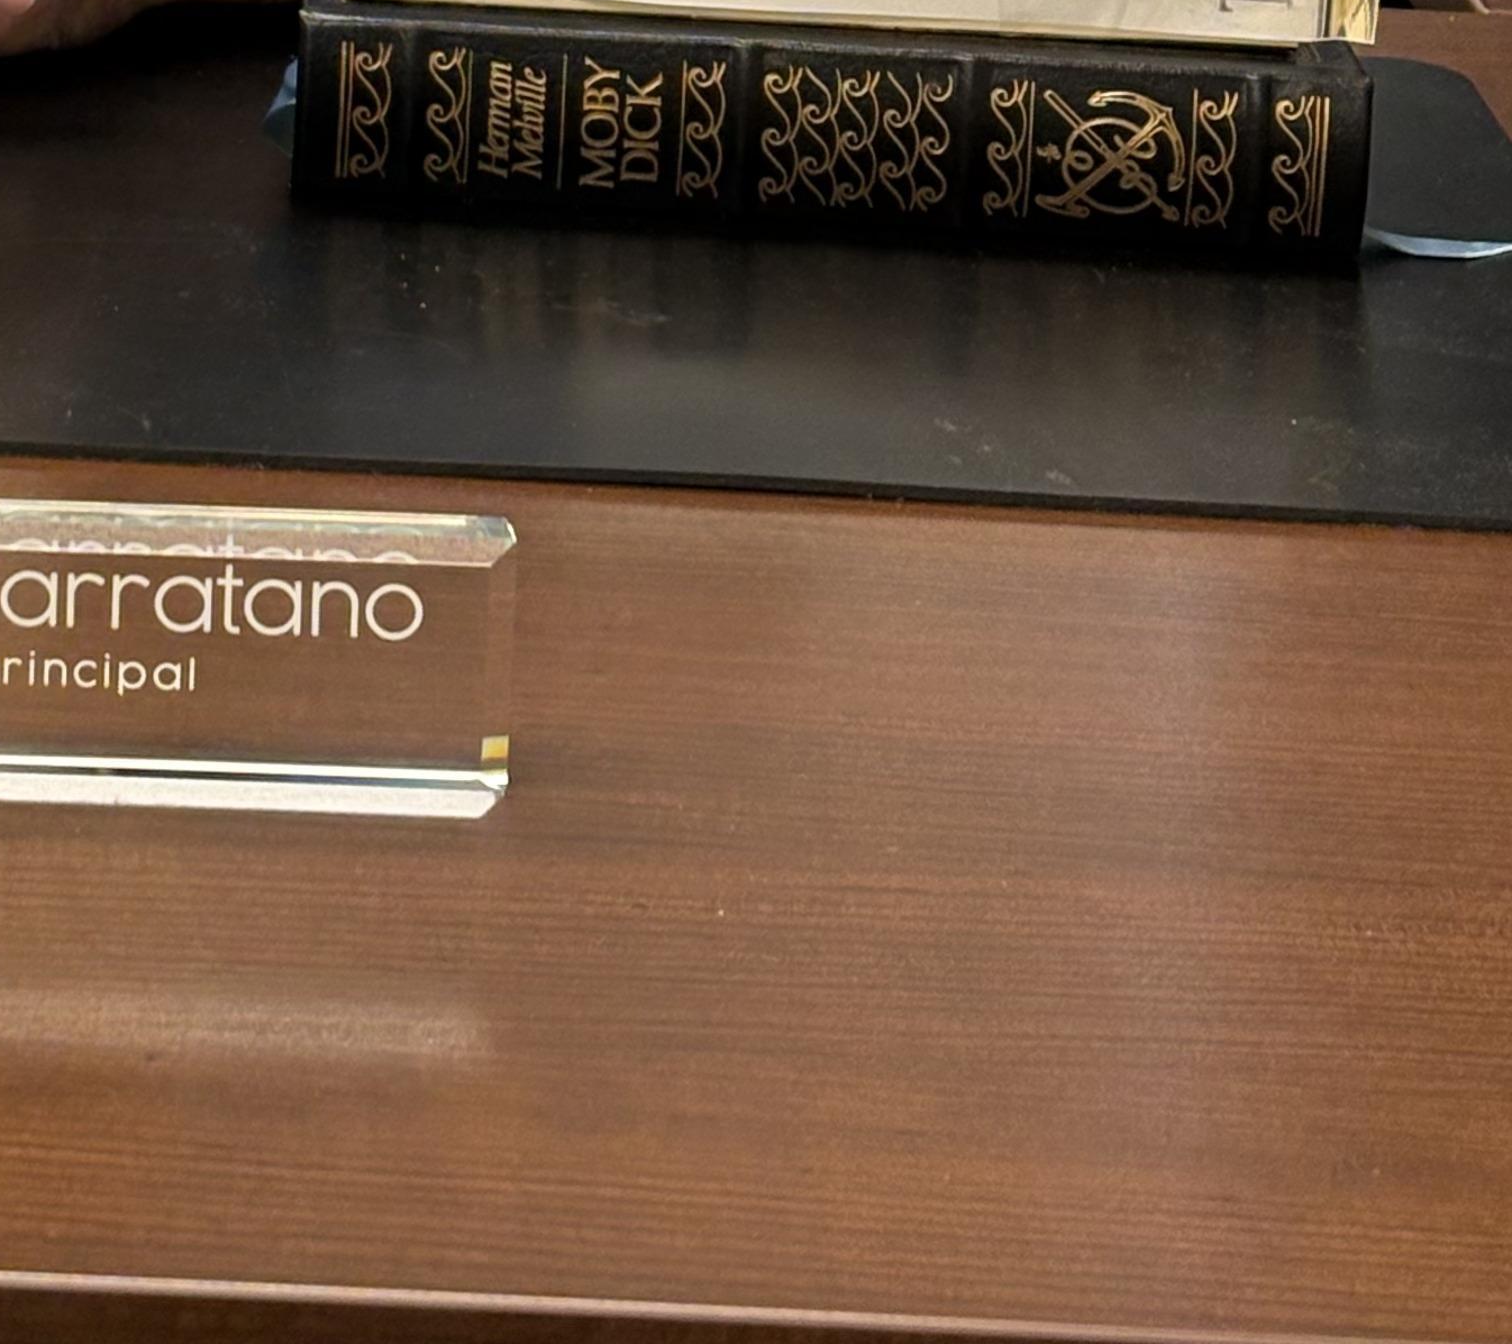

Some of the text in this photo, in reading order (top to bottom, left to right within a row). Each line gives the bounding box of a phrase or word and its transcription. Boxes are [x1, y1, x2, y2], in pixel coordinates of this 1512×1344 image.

[477, 61, 512, 179] Herman
[511, 66, 547, 180] Melville
[578, 56, 621, 188] MOBY
[620, 72, 663, 183] DICK
